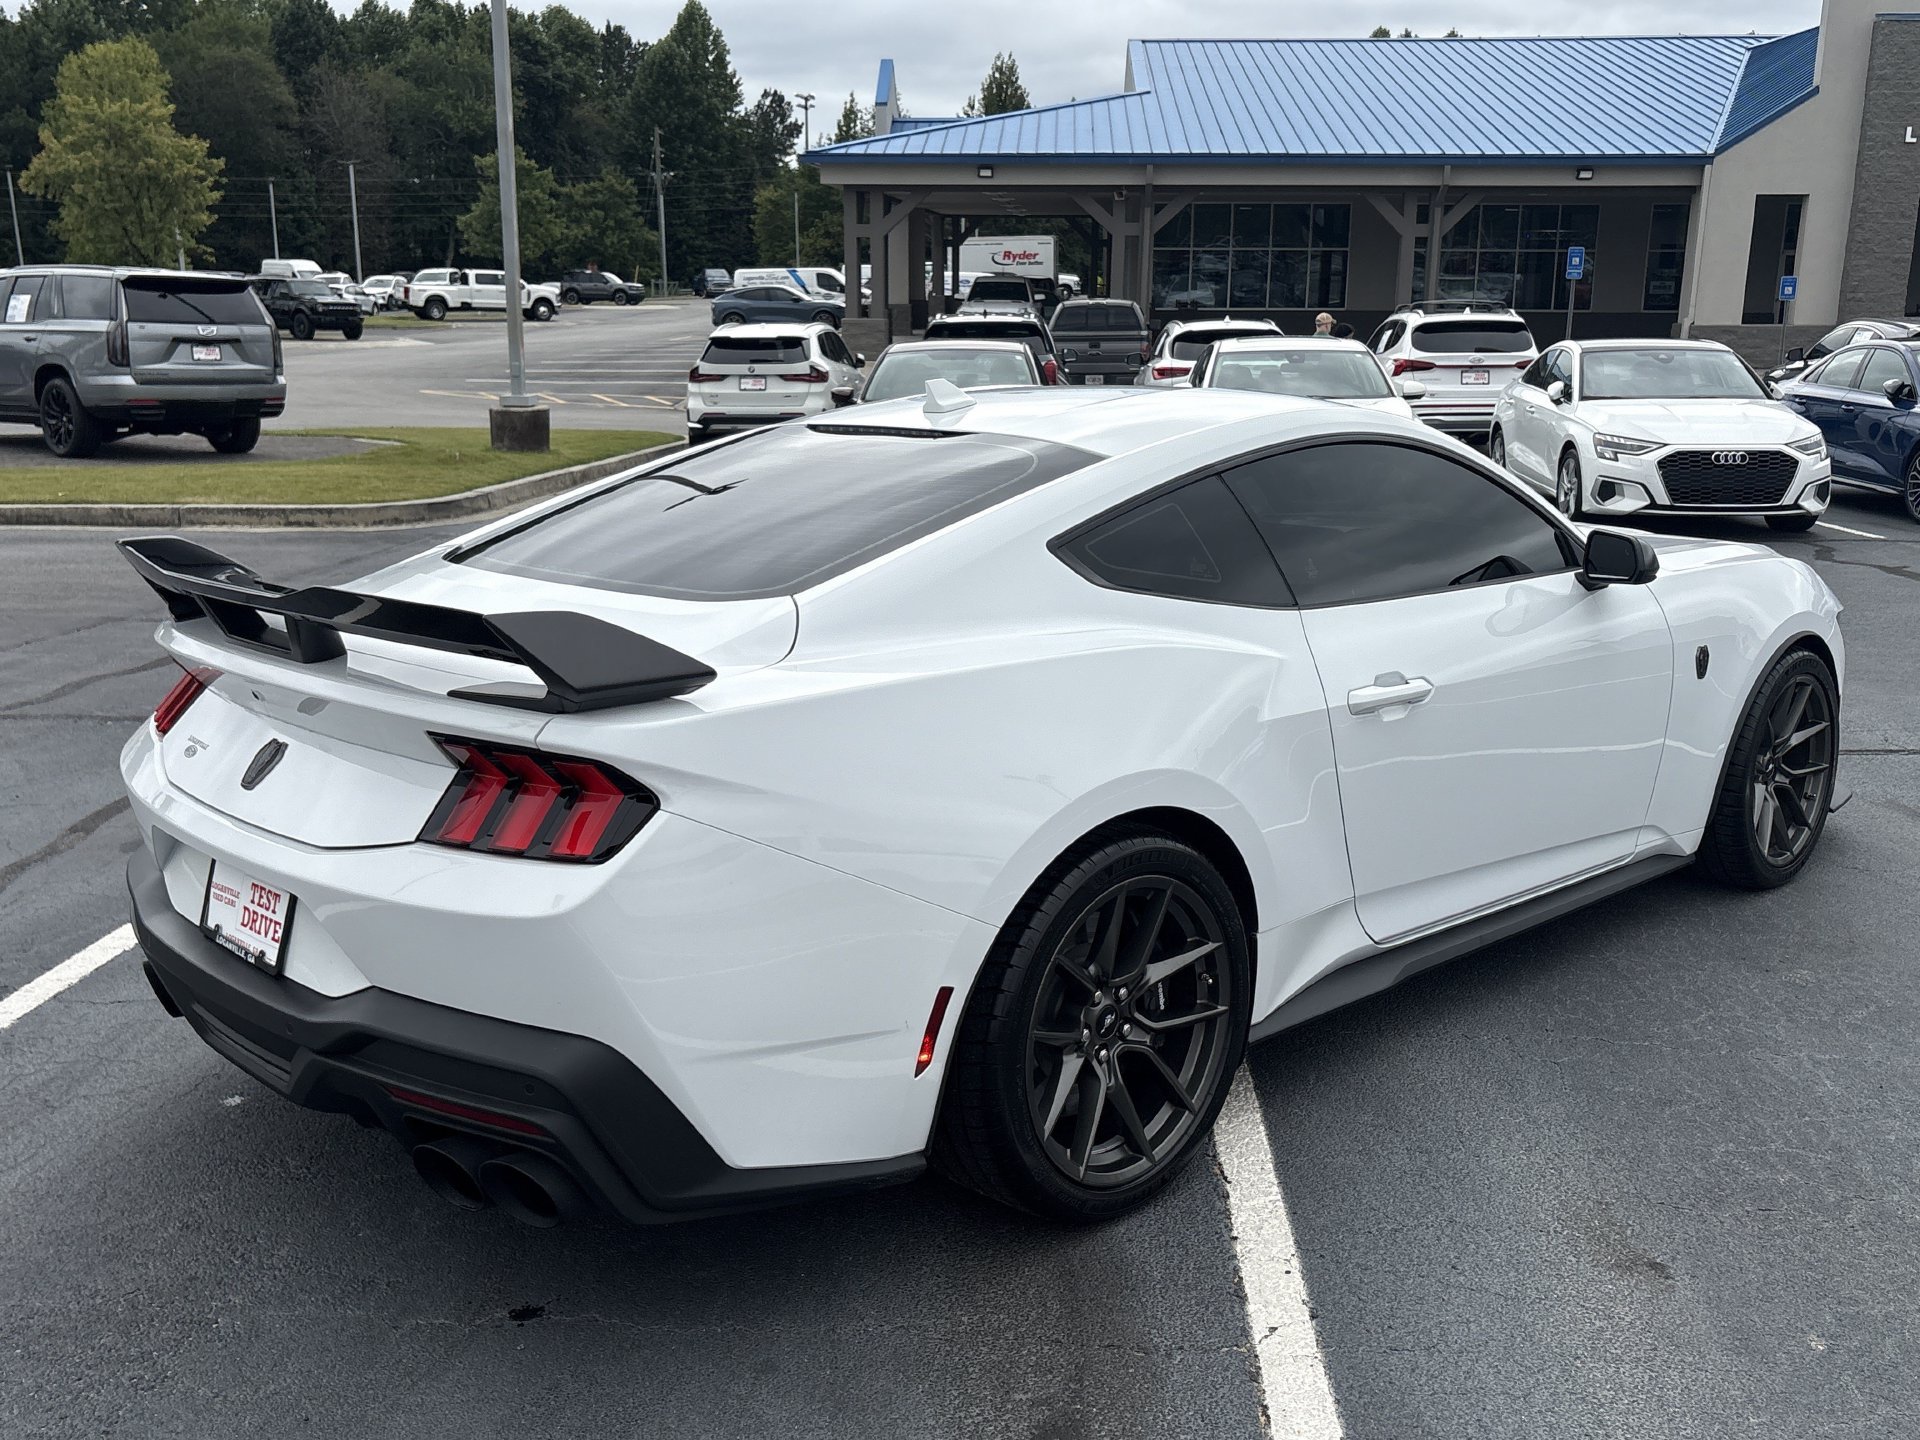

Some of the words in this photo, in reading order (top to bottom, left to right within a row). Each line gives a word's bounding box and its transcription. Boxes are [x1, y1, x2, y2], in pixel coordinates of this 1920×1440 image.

[1003, 250, 1039, 262] Ryder
[211, 881, 240, 899] LOGANVILLE
[250, 882, 281, 914] TEST
[240, 905, 282, 943] DRIVE
[247, 952, 256, 965] GA
